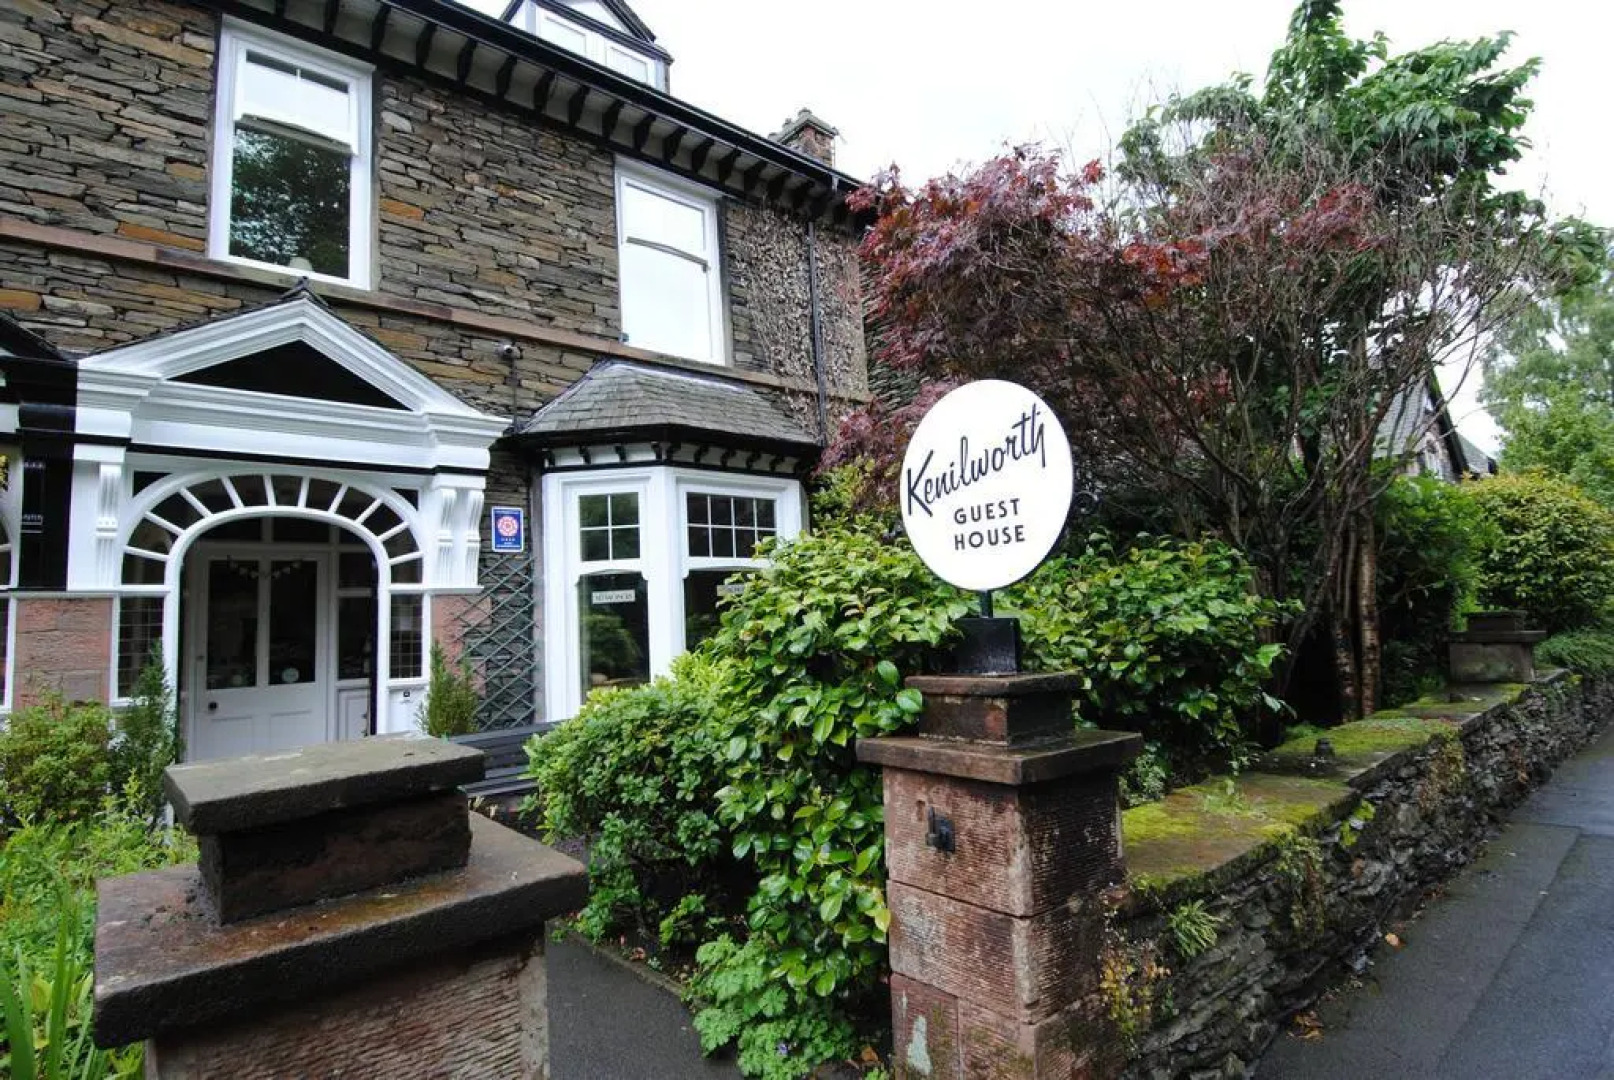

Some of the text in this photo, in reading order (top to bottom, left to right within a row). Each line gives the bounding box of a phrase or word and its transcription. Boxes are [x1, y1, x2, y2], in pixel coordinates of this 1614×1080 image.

[907, 403, 1046, 517] Kenilworth
[954, 499, 1020, 524] GUEST
[954, 525, 1026, 550] HOUSE
